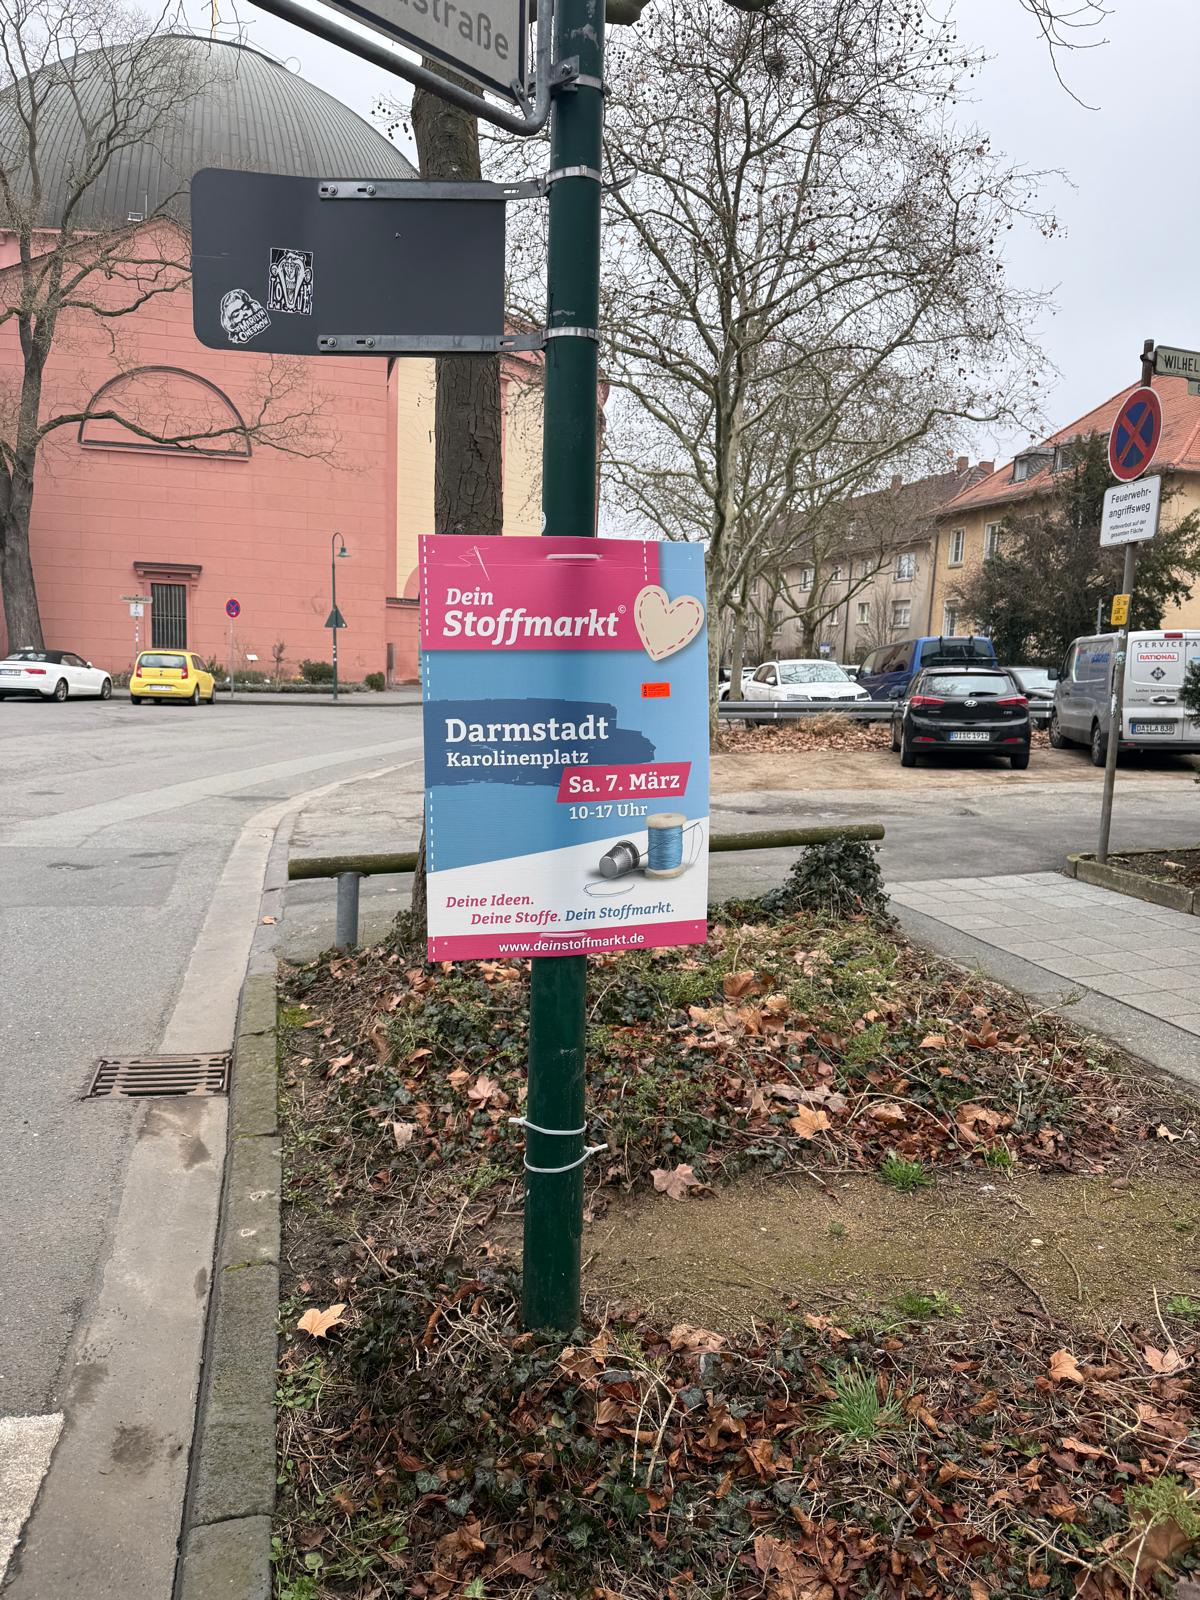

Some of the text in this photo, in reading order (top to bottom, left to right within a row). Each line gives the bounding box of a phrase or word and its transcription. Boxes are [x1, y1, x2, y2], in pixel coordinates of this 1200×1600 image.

[399, 0, 509, 60] straße
[1164, 354, 1199, 372] WILHEL
[1111, 487, 1152, 504] Feuerwehr-
[1108, 502, 1151, 519] angriffsweg
[445, 586, 494, 606] Dein
[445, 714, 610, 743] Darmstadt
[446, 749, 589, 770] Karolinenplatz
[569, 771, 680, 794] Sa. 7. März
[569, 802, 648, 820] 10-17 Uhr
[446, 894, 534, 909] Deine Ideen.
[470, 901, 675, 928] Deine Stoffe. Dein Stoffmarkt.
[499, 932, 645, 953] www.deinstoffmarkt.de
